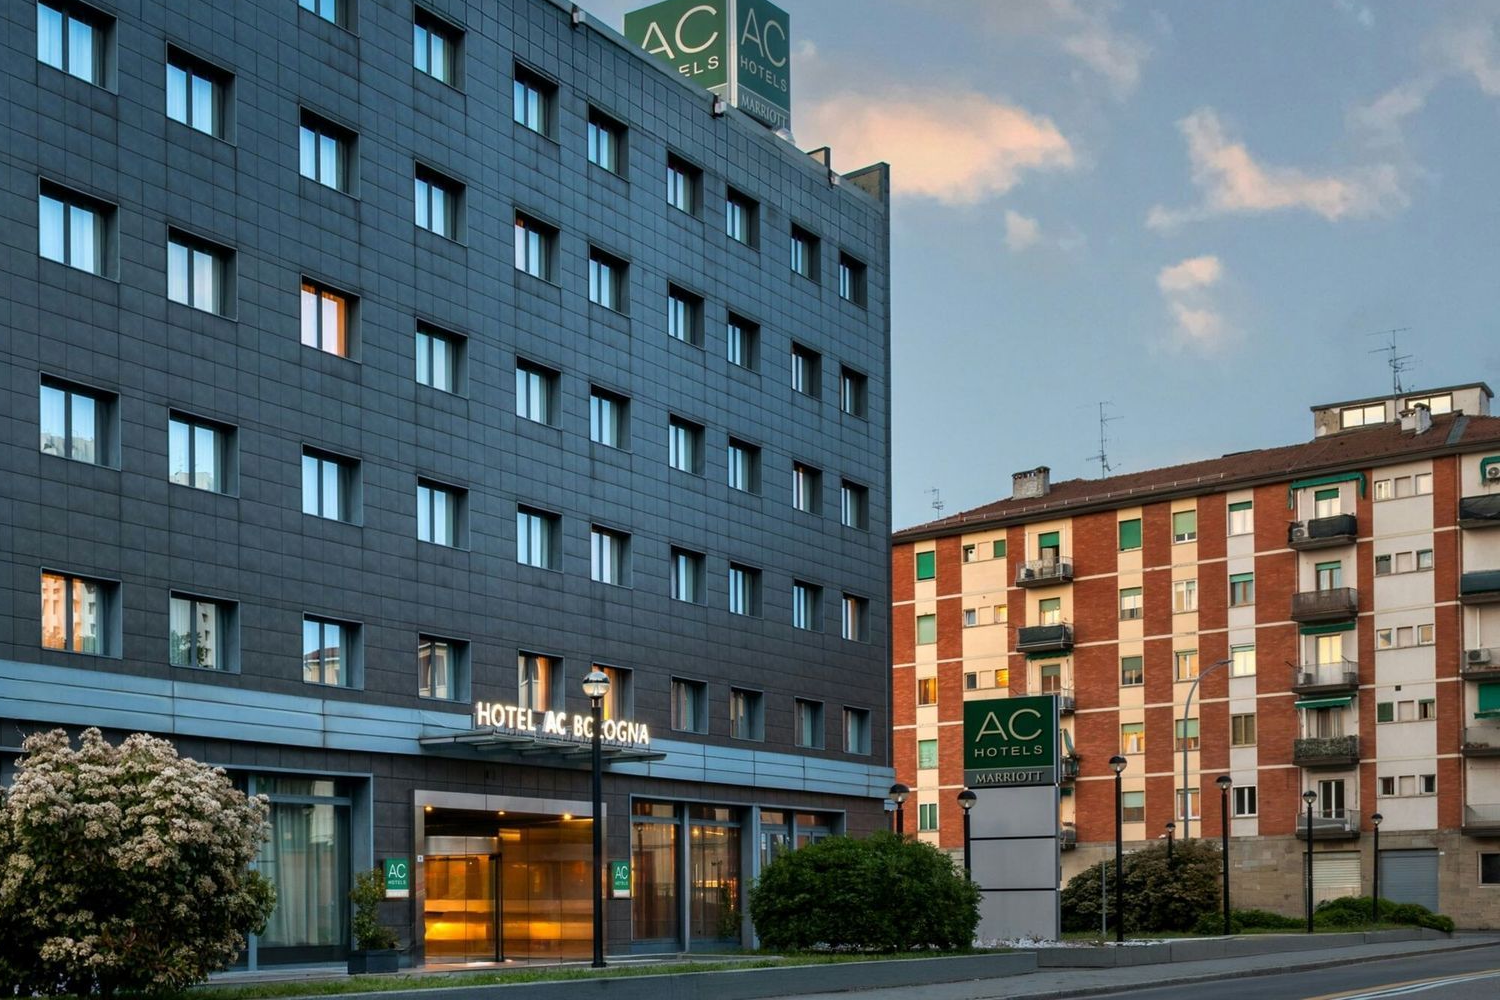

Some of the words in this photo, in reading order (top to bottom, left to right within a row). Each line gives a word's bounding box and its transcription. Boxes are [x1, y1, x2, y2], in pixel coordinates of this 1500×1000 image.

[641, 4, 719, 60] AC
[740, 7, 787, 68] AC
[740, 55, 788, 93] HOTELS
[741, 94, 788, 129] MARRIOTT
[476, 701, 536, 732] HOTEL
[542, 710, 567, 736] AC
[573, 714, 649, 745] BOOGNA
[975, 708, 1043, 743] AC
[974, 744, 1043, 758] HOTELS
[975, 770, 1044, 784] MARRIOTT
[388, 863, 406, 879] AC
[614, 865, 629, 880] AC
